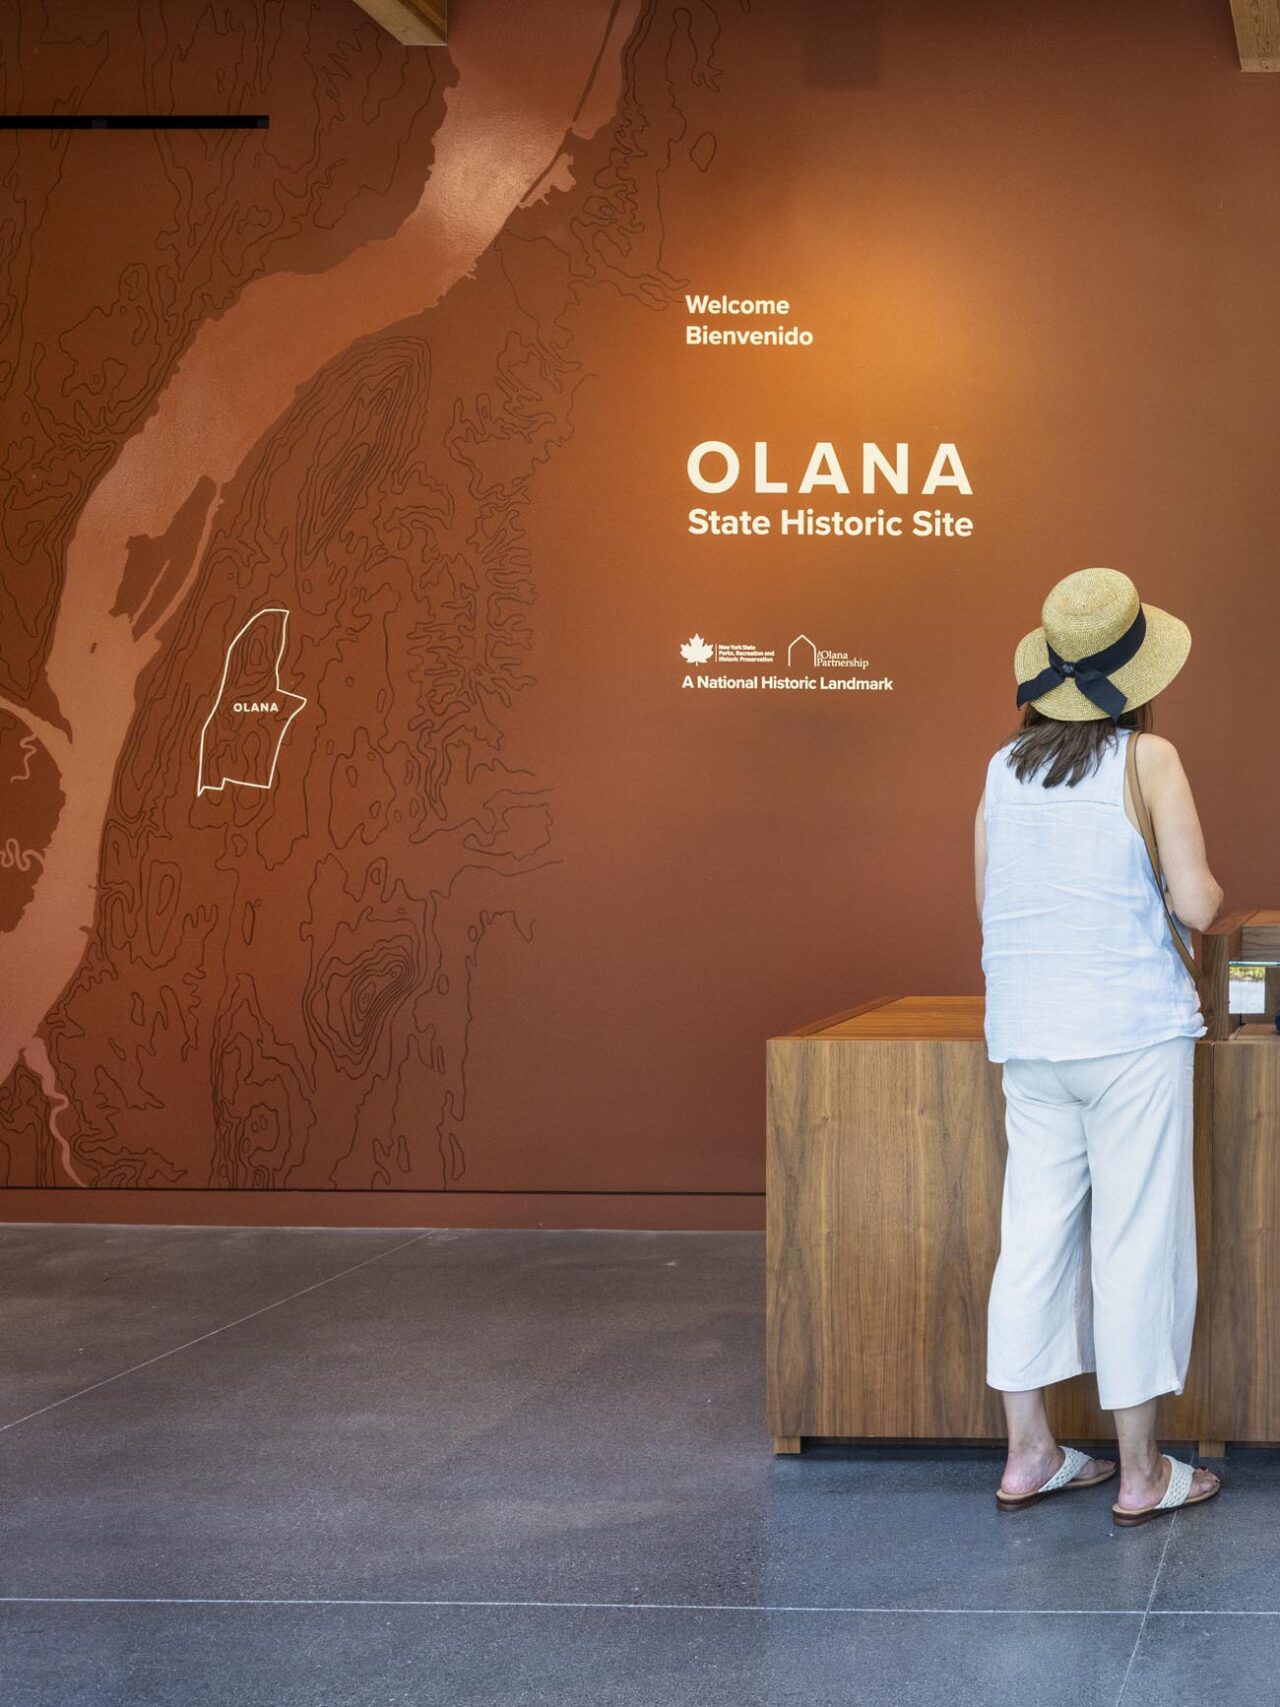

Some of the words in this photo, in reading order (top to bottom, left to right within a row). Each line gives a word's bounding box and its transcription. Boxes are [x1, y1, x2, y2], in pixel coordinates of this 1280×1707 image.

[685, 294, 790, 315] Welcome
[685, 325, 814, 346] Bienvenido
[687, 440, 973, 496] OLANA
[688, 508, 771, 535] State
[781, 508, 903, 536] Historic
[912, 509, 974, 537] Site
[816, 657, 870, 670] Partnership
[820, 650, 849, 660] Olana
[682, 676, 694, 689] A
[697, 676, 758, 689] National
[761, 676, 816, 689] Historic
[820, 676, 893, 690] Landmark
[233, 702, 279, 713] OLANA
